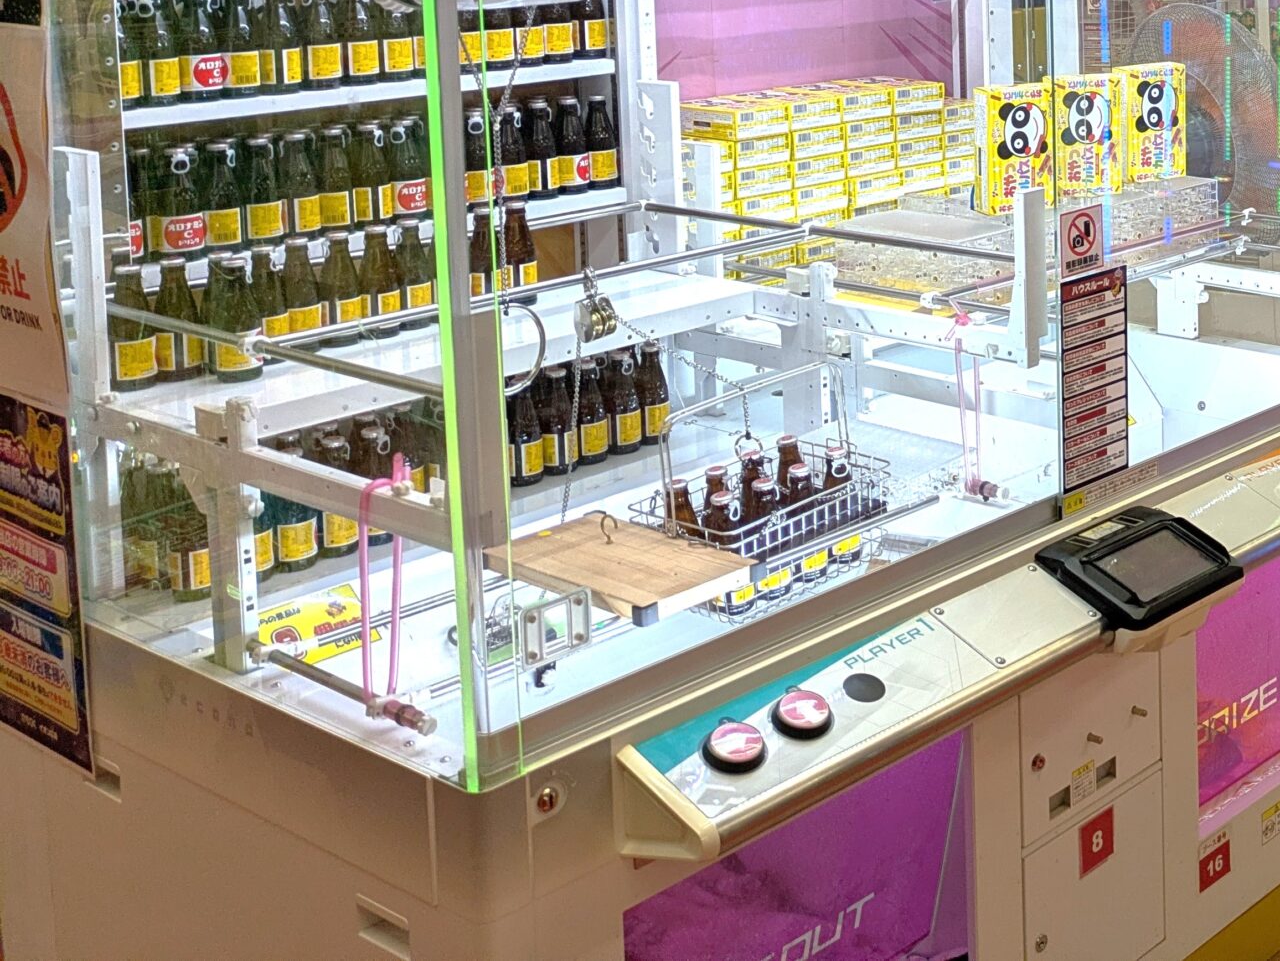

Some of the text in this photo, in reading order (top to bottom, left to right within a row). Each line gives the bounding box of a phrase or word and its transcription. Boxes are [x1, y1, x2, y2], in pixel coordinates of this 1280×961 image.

[1071, 278, 1110, 296] ハウスルール
[1092, 830, 1103, 853] 8
[1207, 854, 1223, 877] 16
[760, 892, 875, 961] OUT
